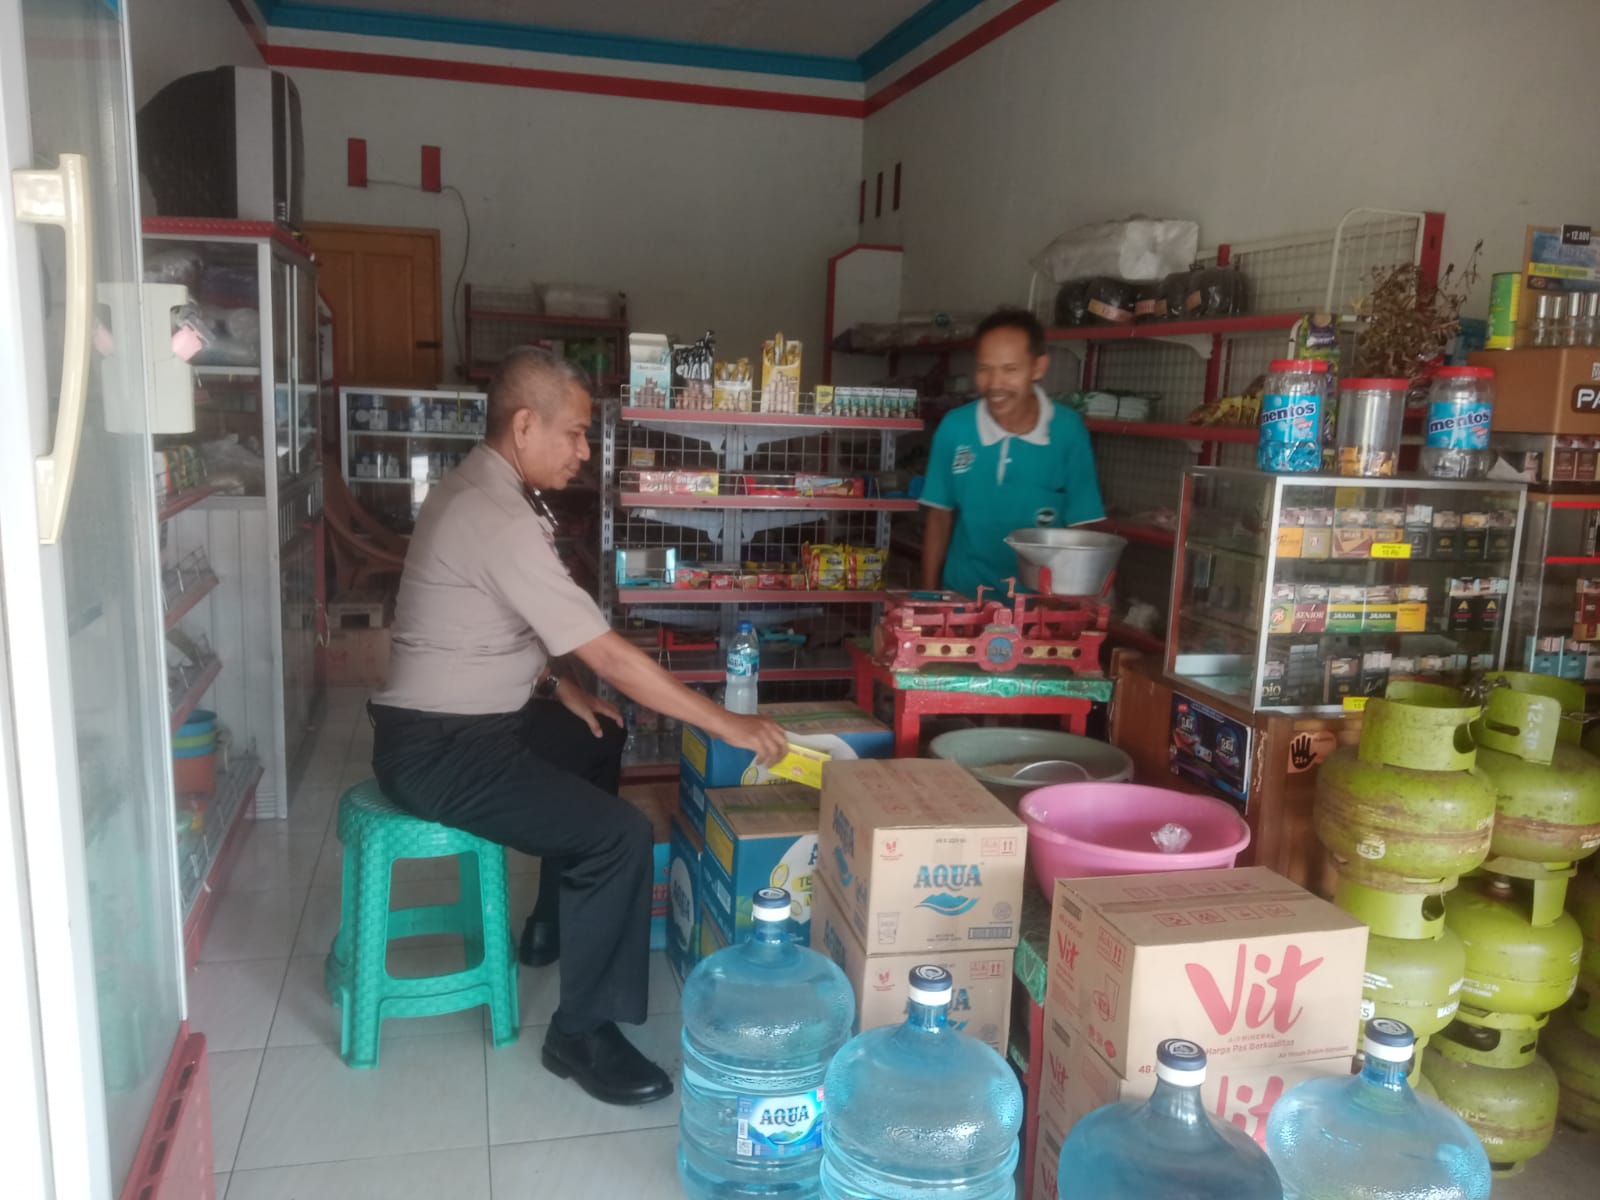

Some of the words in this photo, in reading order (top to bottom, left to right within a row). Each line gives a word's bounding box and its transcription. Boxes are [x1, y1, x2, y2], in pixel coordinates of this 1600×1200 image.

[1430, 412, 1489, 433] mentos
[913, 863, 983, 891] AQUA
[1185, 943, 1324, 1035] Vit
[759, 1105, 810, 1127] AQUA
